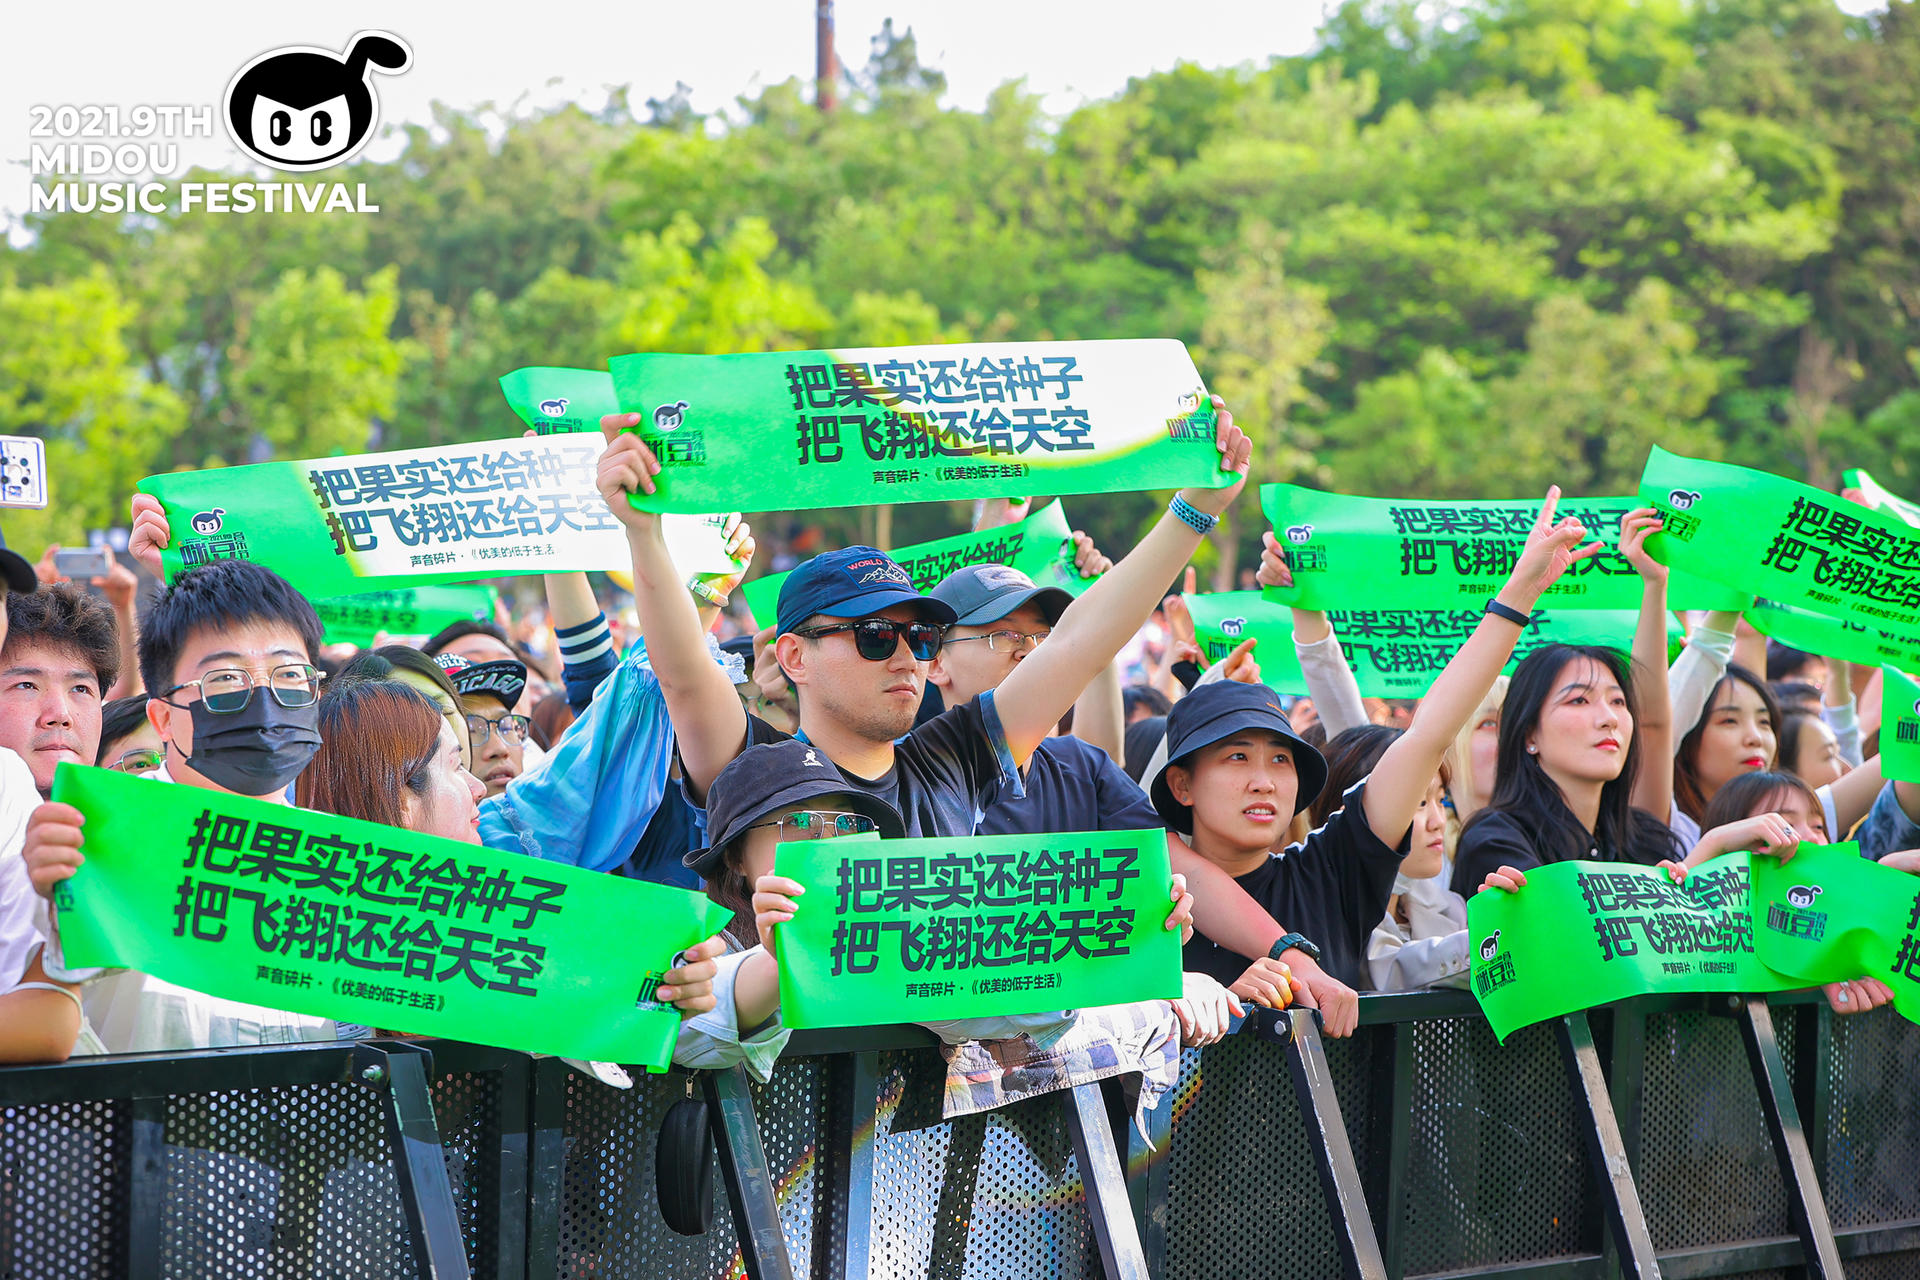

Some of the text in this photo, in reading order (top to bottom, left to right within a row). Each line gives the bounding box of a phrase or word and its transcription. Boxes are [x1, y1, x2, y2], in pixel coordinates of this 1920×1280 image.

[784, 356, 1083, 411] 把果实还给种子
[796, 405, 1095, 465] 把飞翔还给天空
[309, 446, 599, 510] 把果实还给种子
[326, 493, 620, 555] 把飞翔还给天空
[846, 558, 884, 571] WORLD
[453, 673, 524, 695] ICAGO
[183, 808, 567, 931] 把果实还给种子
[836, 848, 1139, 914] 把果实还给种子
[173, 875, 546, 997] 把飞翔还给天空
[831, 906, 1135, 976] 把飞翔还给天空
